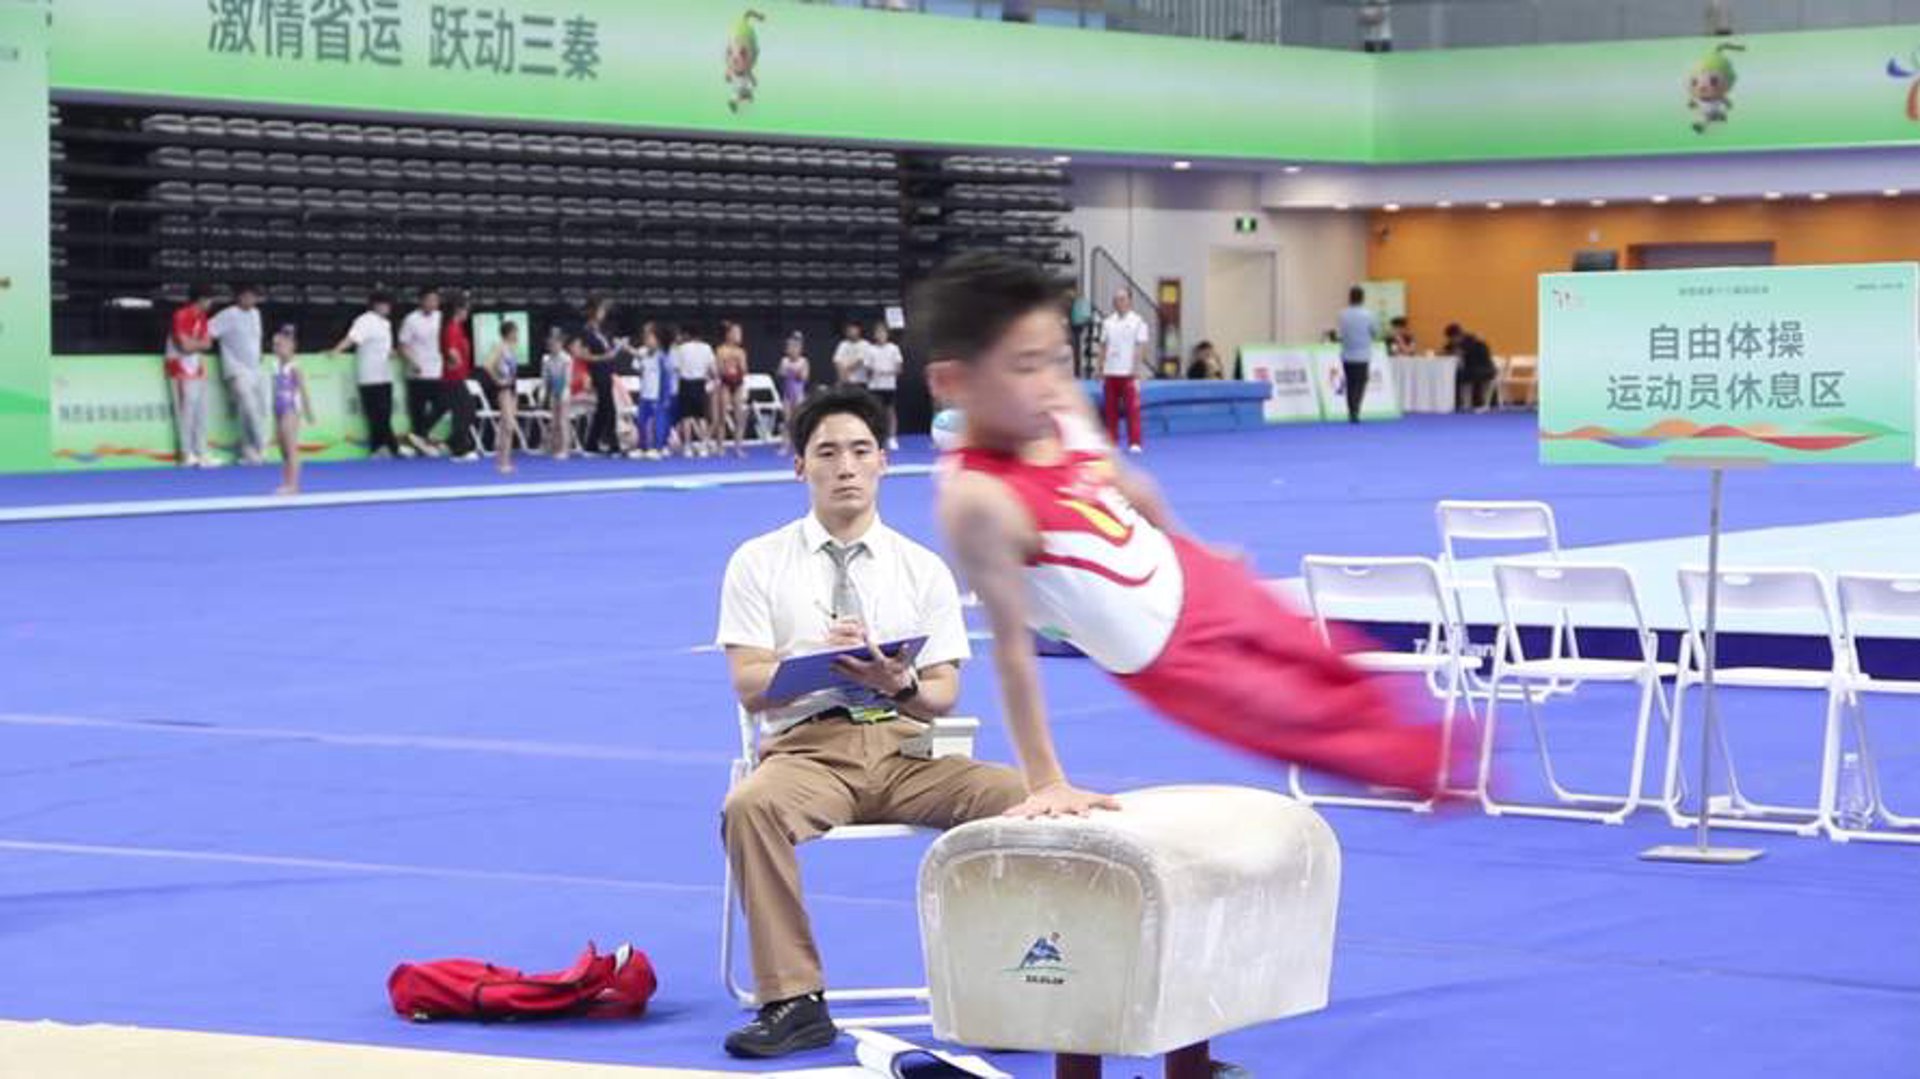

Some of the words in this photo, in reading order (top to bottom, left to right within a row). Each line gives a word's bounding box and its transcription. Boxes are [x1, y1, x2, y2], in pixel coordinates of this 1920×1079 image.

[207, 0, 402, 67] 激情省运
[428, 4, 601, 80] 跃动三秦
[1648, 321, 1806, 362] 自由体操
[1606, 371, 1847, 412] 运动员休息区
